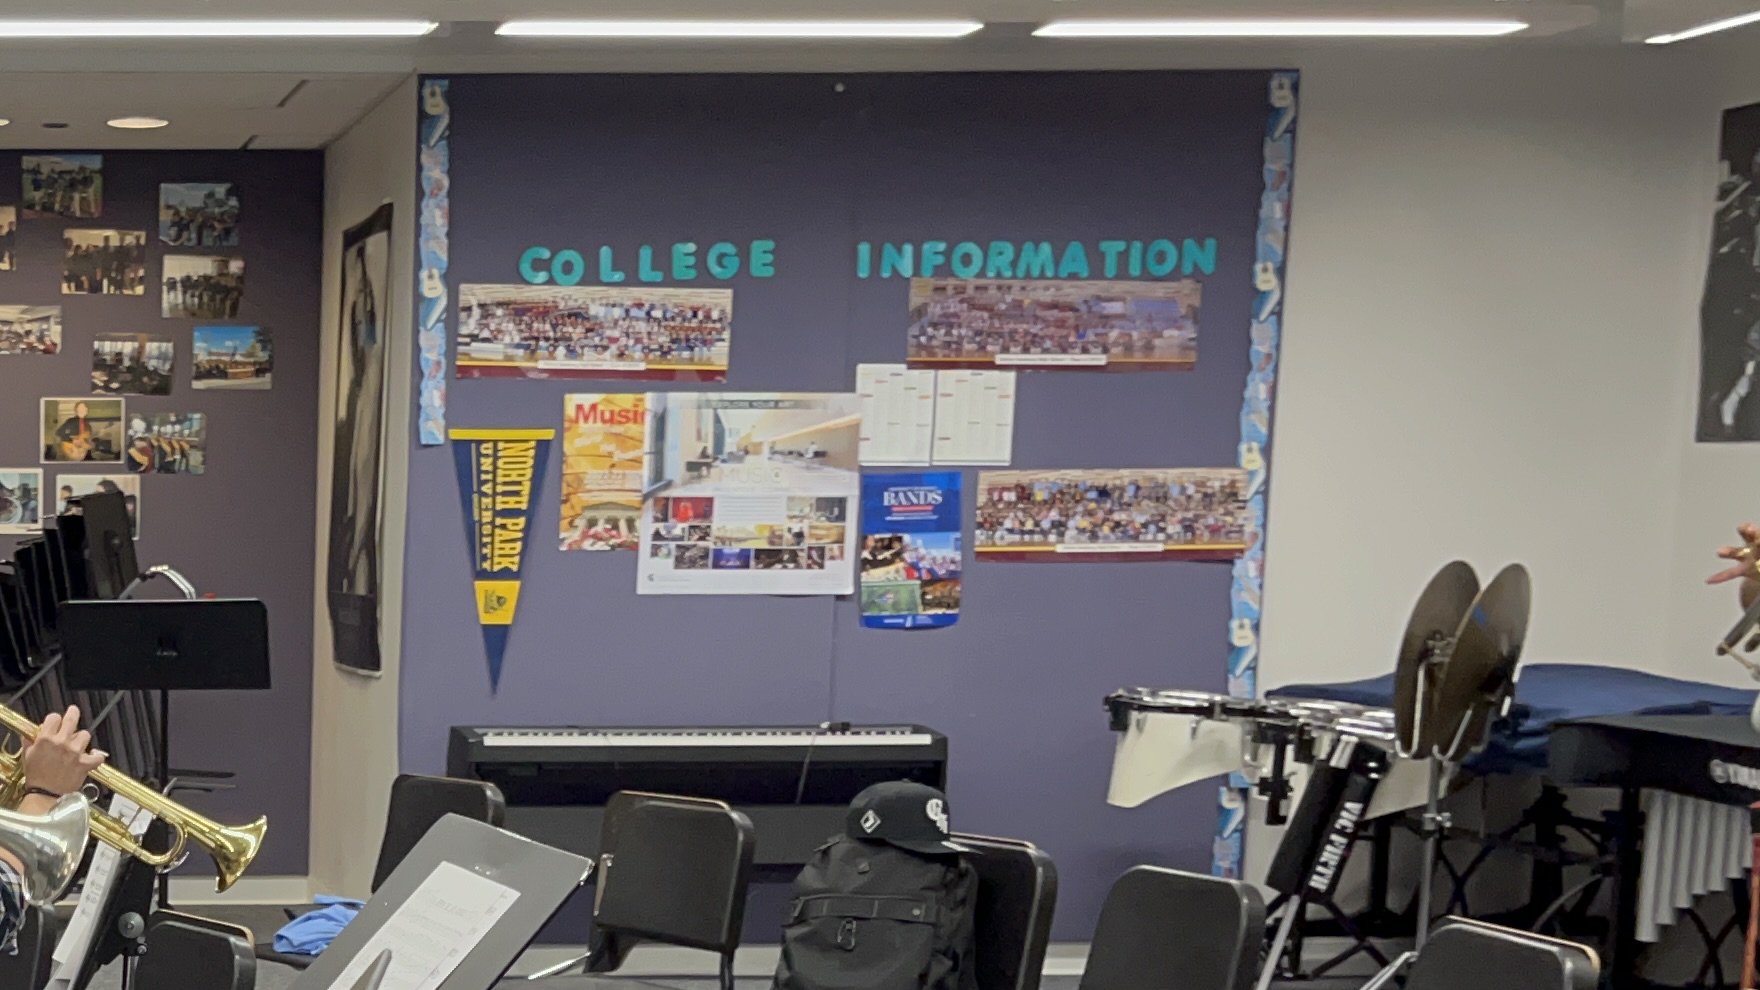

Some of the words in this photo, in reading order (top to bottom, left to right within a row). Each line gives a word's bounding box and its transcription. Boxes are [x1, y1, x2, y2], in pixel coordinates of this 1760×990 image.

[518, 240, 775, 286] COLLEGE
[856, 238, 1217, 279] INFORMATION
[495, 441, 537, 510] NORTH
[883, 489, 943, 506] BANDS
[479, 441, 493, 571] UNIVERSITY
[493, 516, 527, 572] PARK
